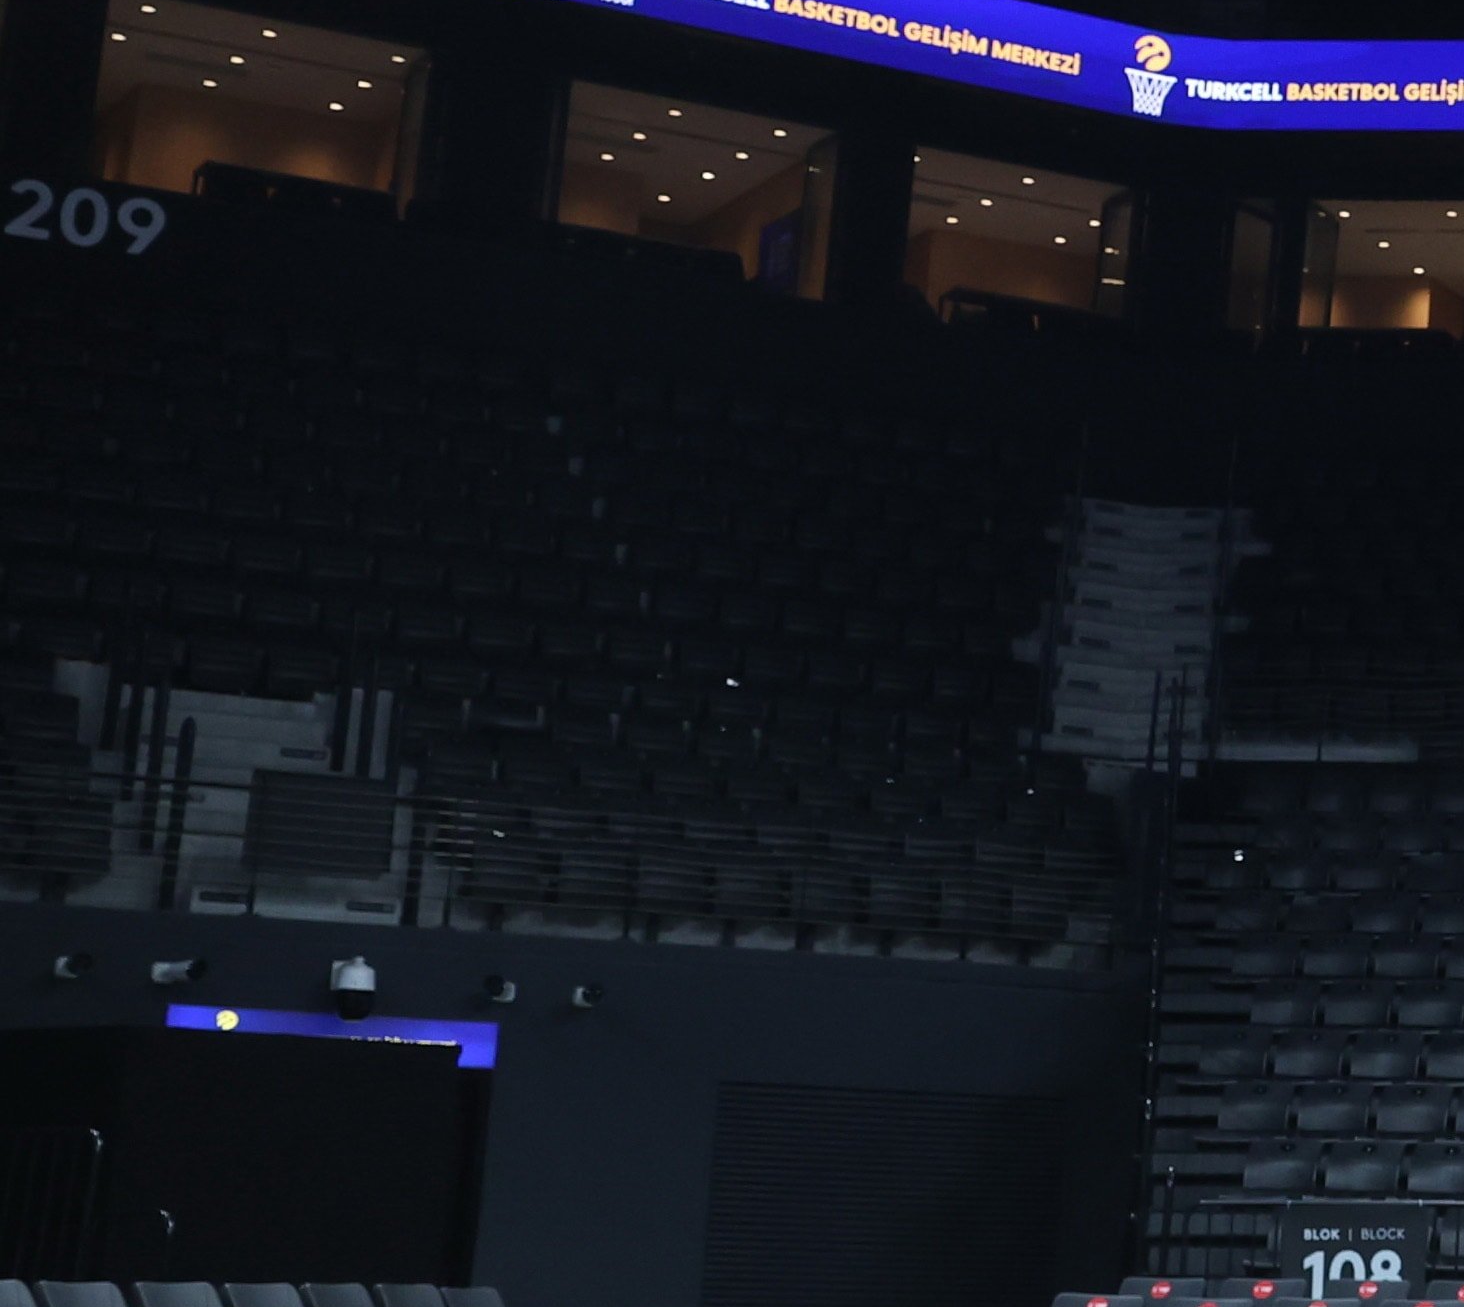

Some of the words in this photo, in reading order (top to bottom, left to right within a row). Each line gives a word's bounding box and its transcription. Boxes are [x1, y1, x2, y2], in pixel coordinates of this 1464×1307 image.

[903, 21, 989, 57] GELİŞİM
[990, 39, 1081, 76] MERKEZİ
[1184, 78, 1284, 102] TURKCELL
[1285, 82, 1401, 102] BASKETBOL
[4, 179, 166, 255] 209
[1303, 1227, 1341, 1241] BLOK
[1360, 1227, 1406, 1241] BLOCK
